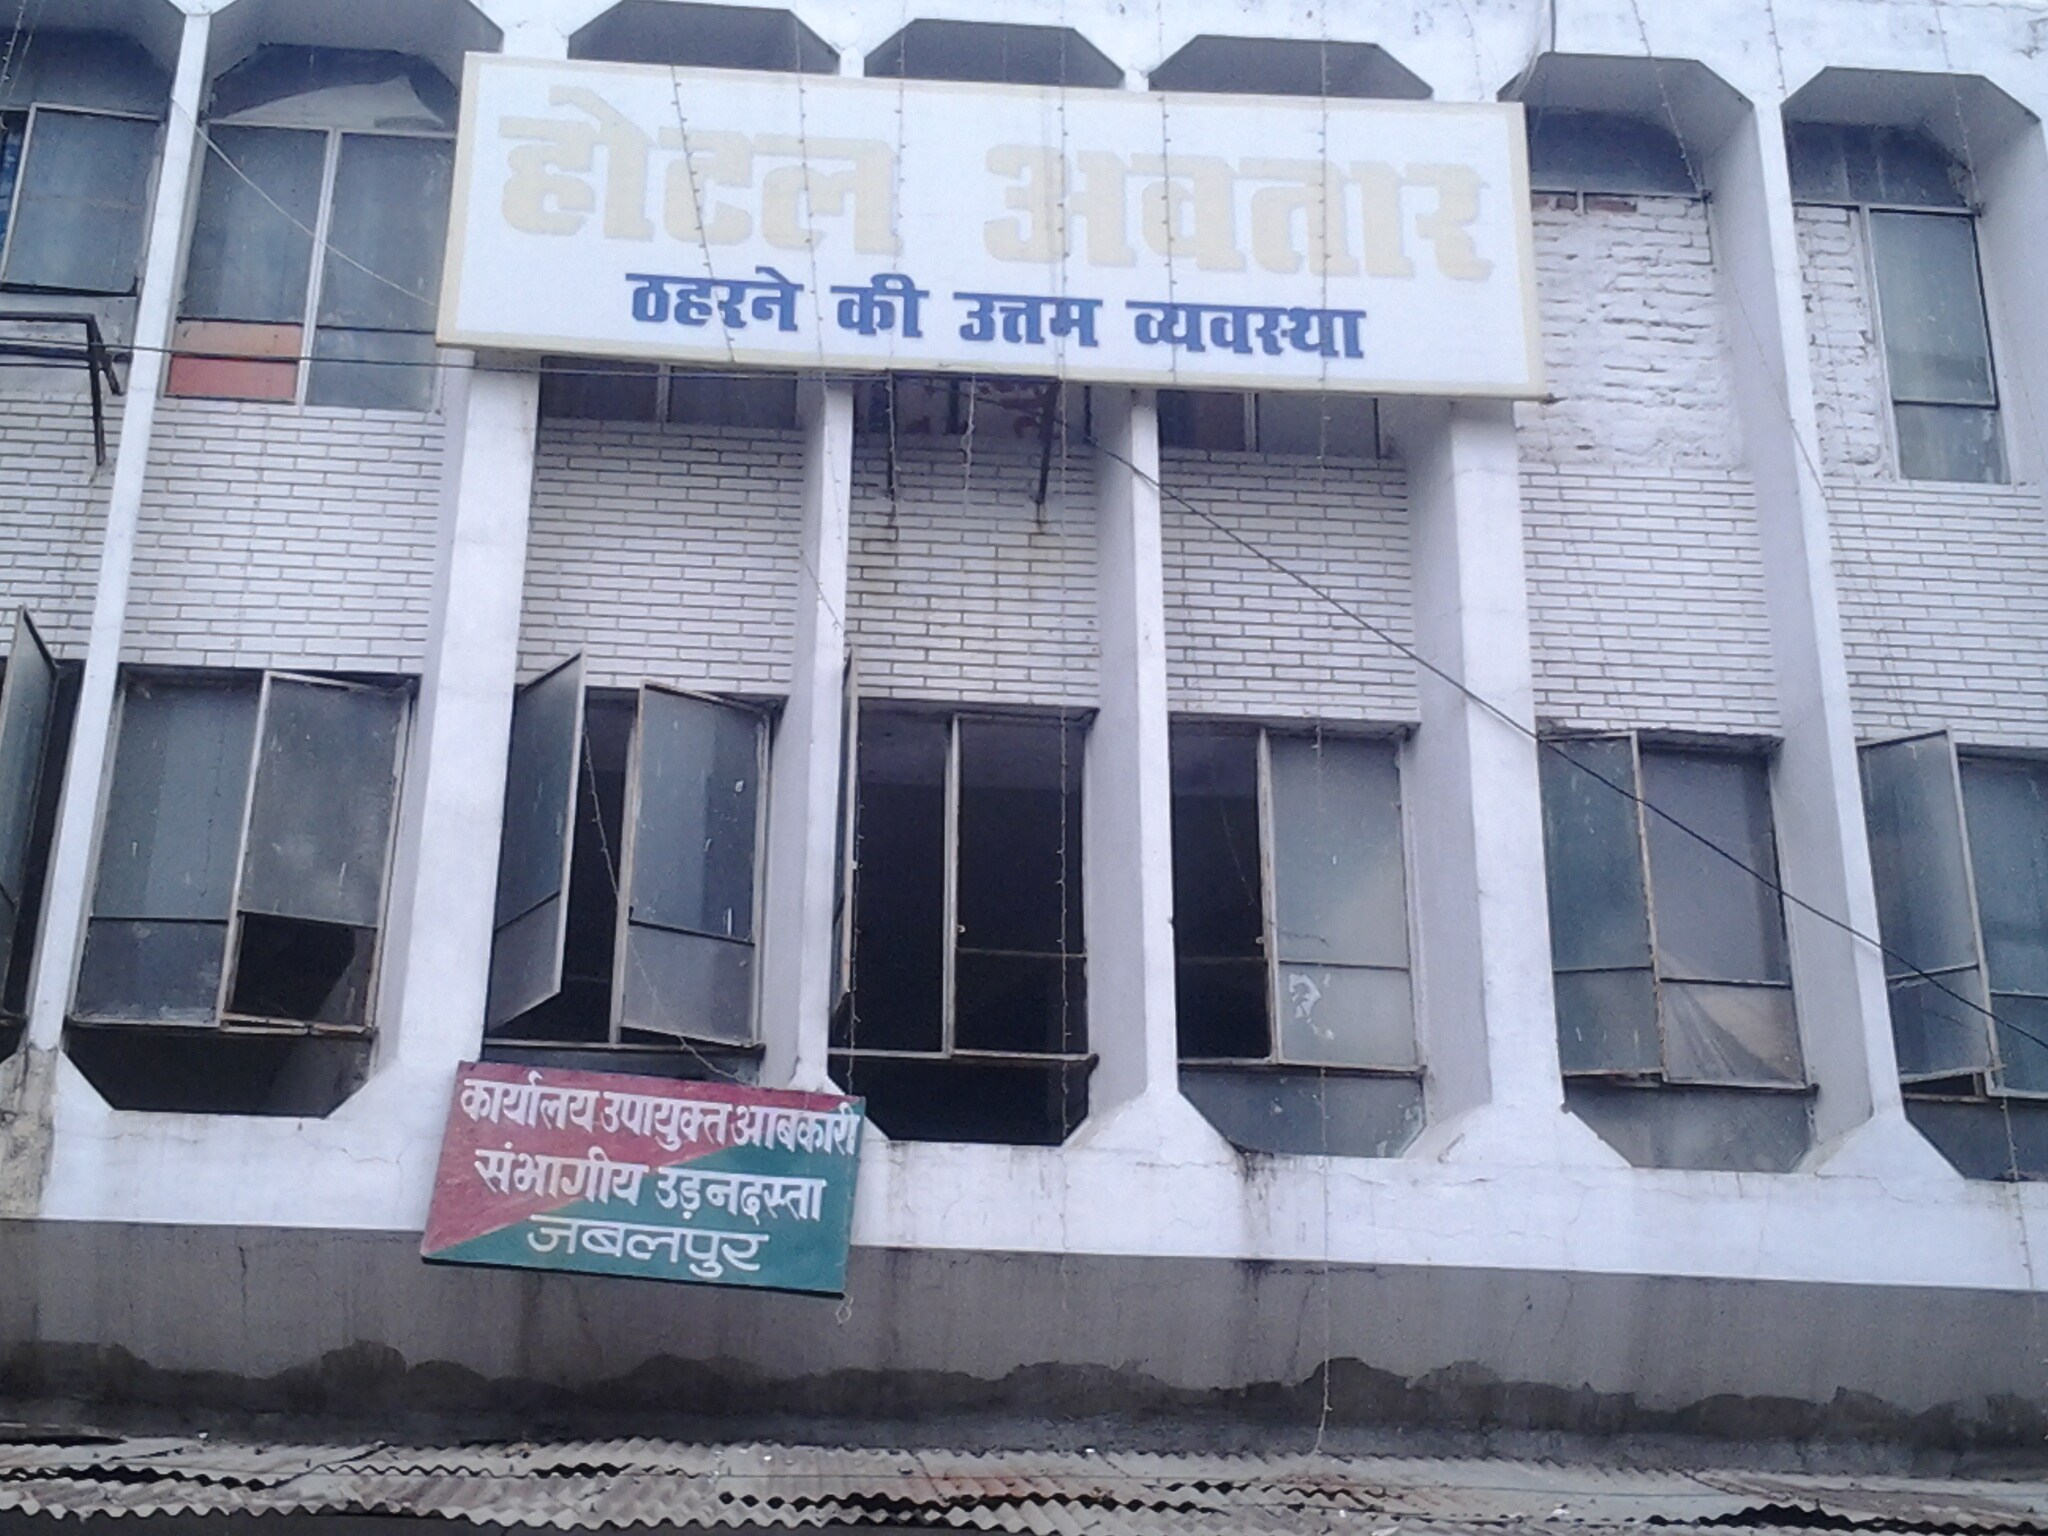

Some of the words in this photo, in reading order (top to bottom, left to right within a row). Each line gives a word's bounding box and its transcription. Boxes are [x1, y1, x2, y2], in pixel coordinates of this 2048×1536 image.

[500, 85, 902, 257] होटल
[983, 144, 1492, 282] अवतार
[626, 266, 804, 332] ठहरने
[831, 273, 930, 339] की
[953, 291, 1103, 348] उत्तम
[1125, 300, 1367, 359] व्यवस्था
[460, 1071, 600, 1134] कार्यालय
[602, 1091, 732, 1152] उपायुक्त
[732, 1102, 861, 1156] आबकारी
[474, 1141, 649, 1205] संभागीय
[655, 1166, 828, 1225] उड़नदस्ता
[527, 1214, 770, 1279] जबलपुर
